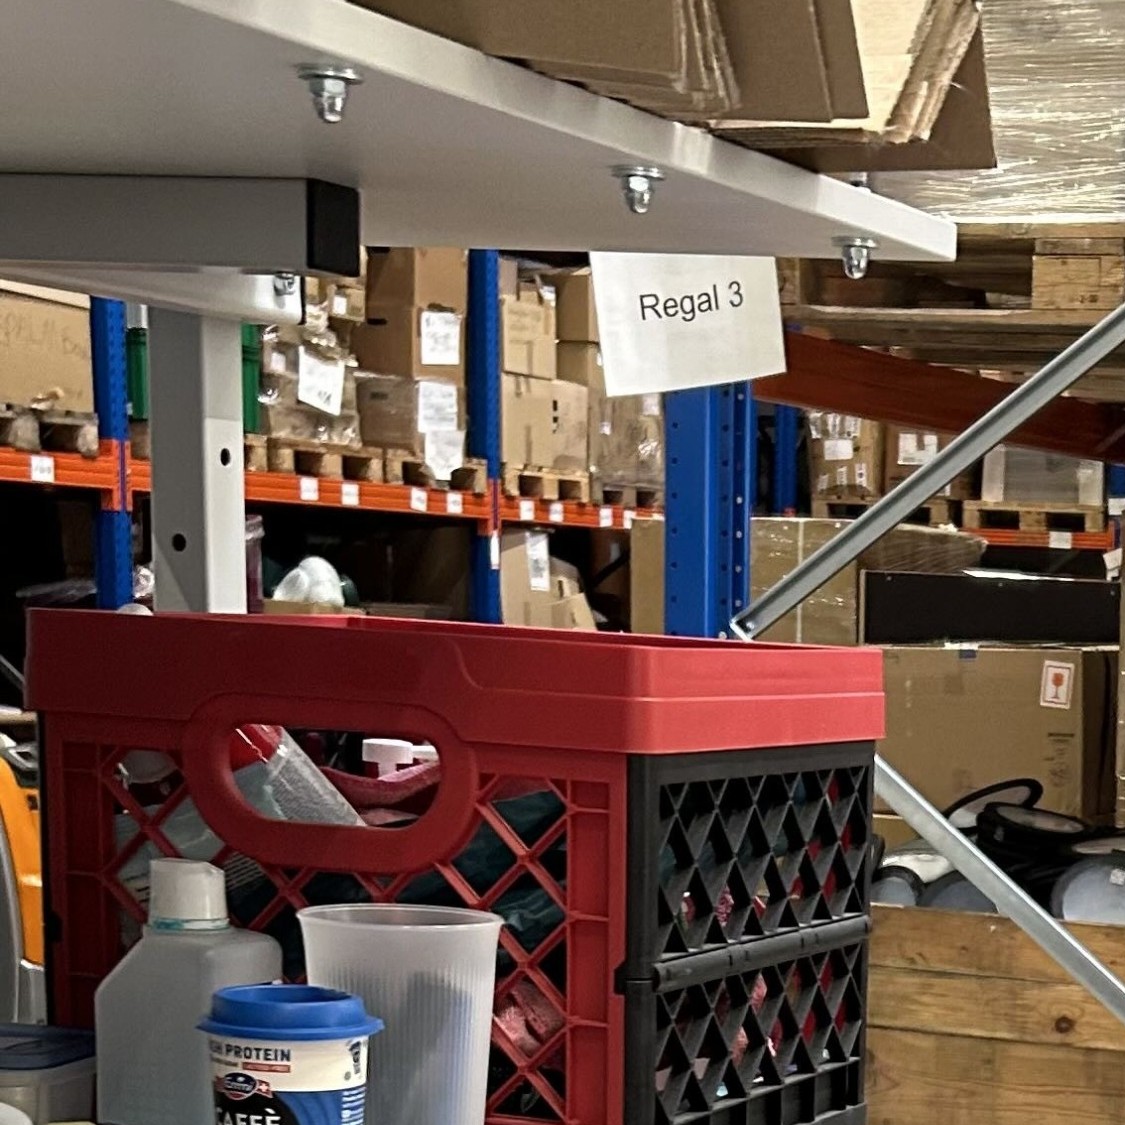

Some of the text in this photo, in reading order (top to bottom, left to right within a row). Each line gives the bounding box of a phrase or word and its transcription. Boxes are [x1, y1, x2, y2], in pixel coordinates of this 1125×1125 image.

[639, 281, 744, 322] Regal 3
[225, 1044, 291, 1062] PROTEIN
